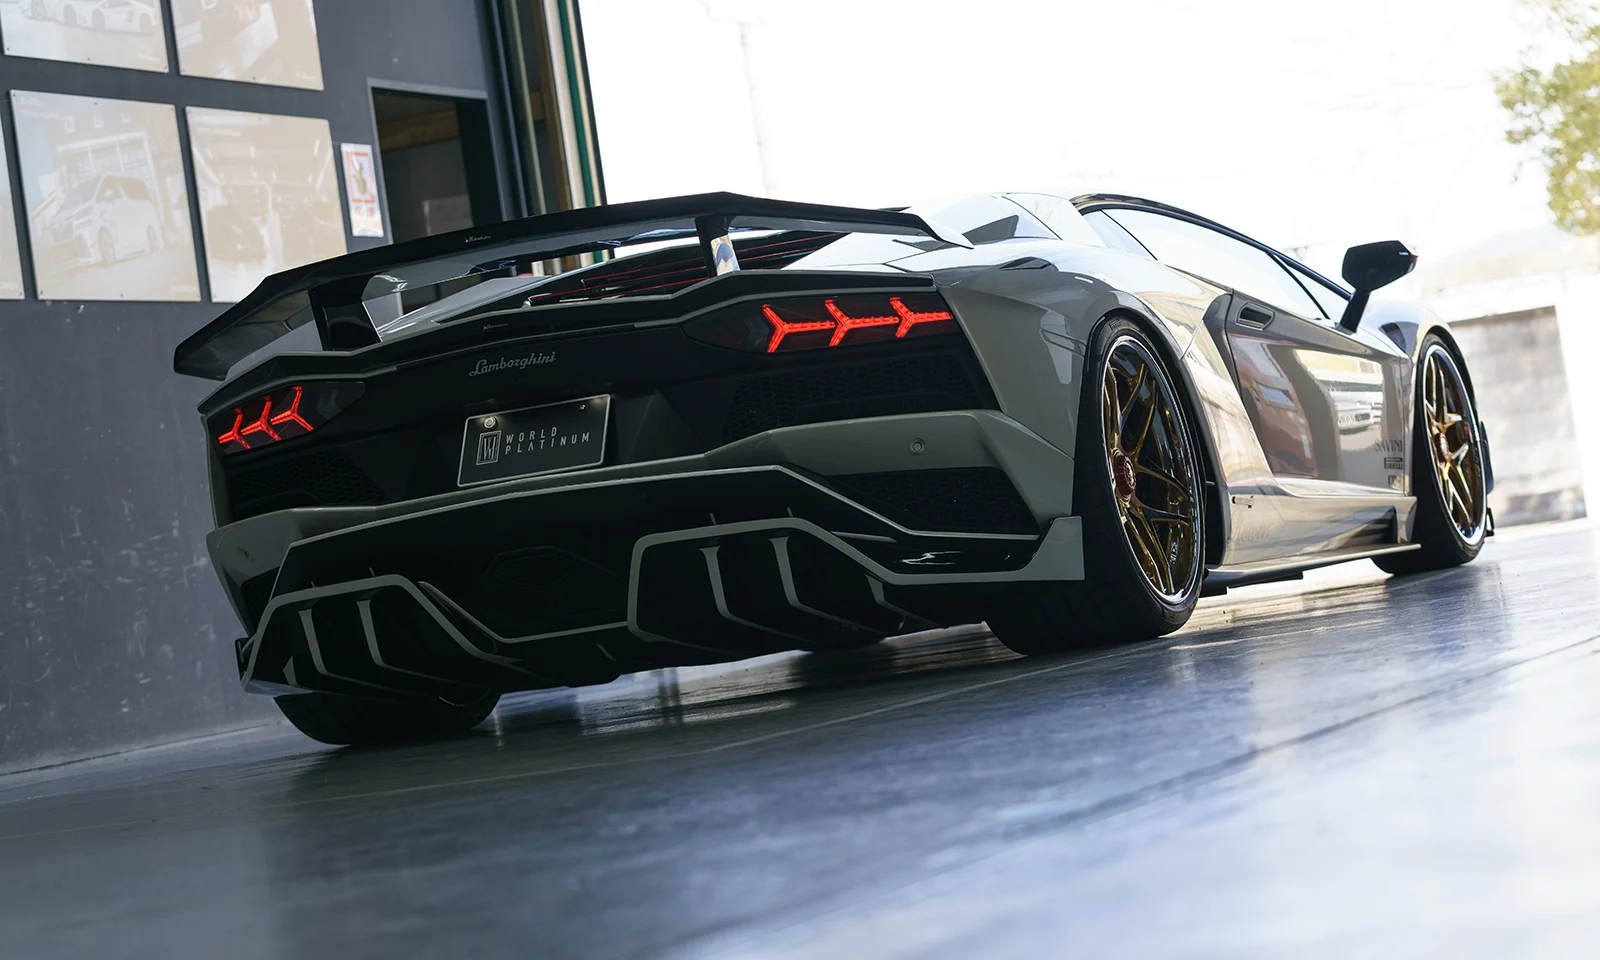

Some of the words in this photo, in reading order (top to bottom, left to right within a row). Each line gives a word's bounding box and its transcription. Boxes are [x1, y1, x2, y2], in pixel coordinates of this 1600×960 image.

[468, 351, 557, 377] Lamborghini
[504, 432, 591, 455] PLATINUM
[506, 426, 558, 444] WORLD
[1374, 439, 1403, 452] SAVINI
